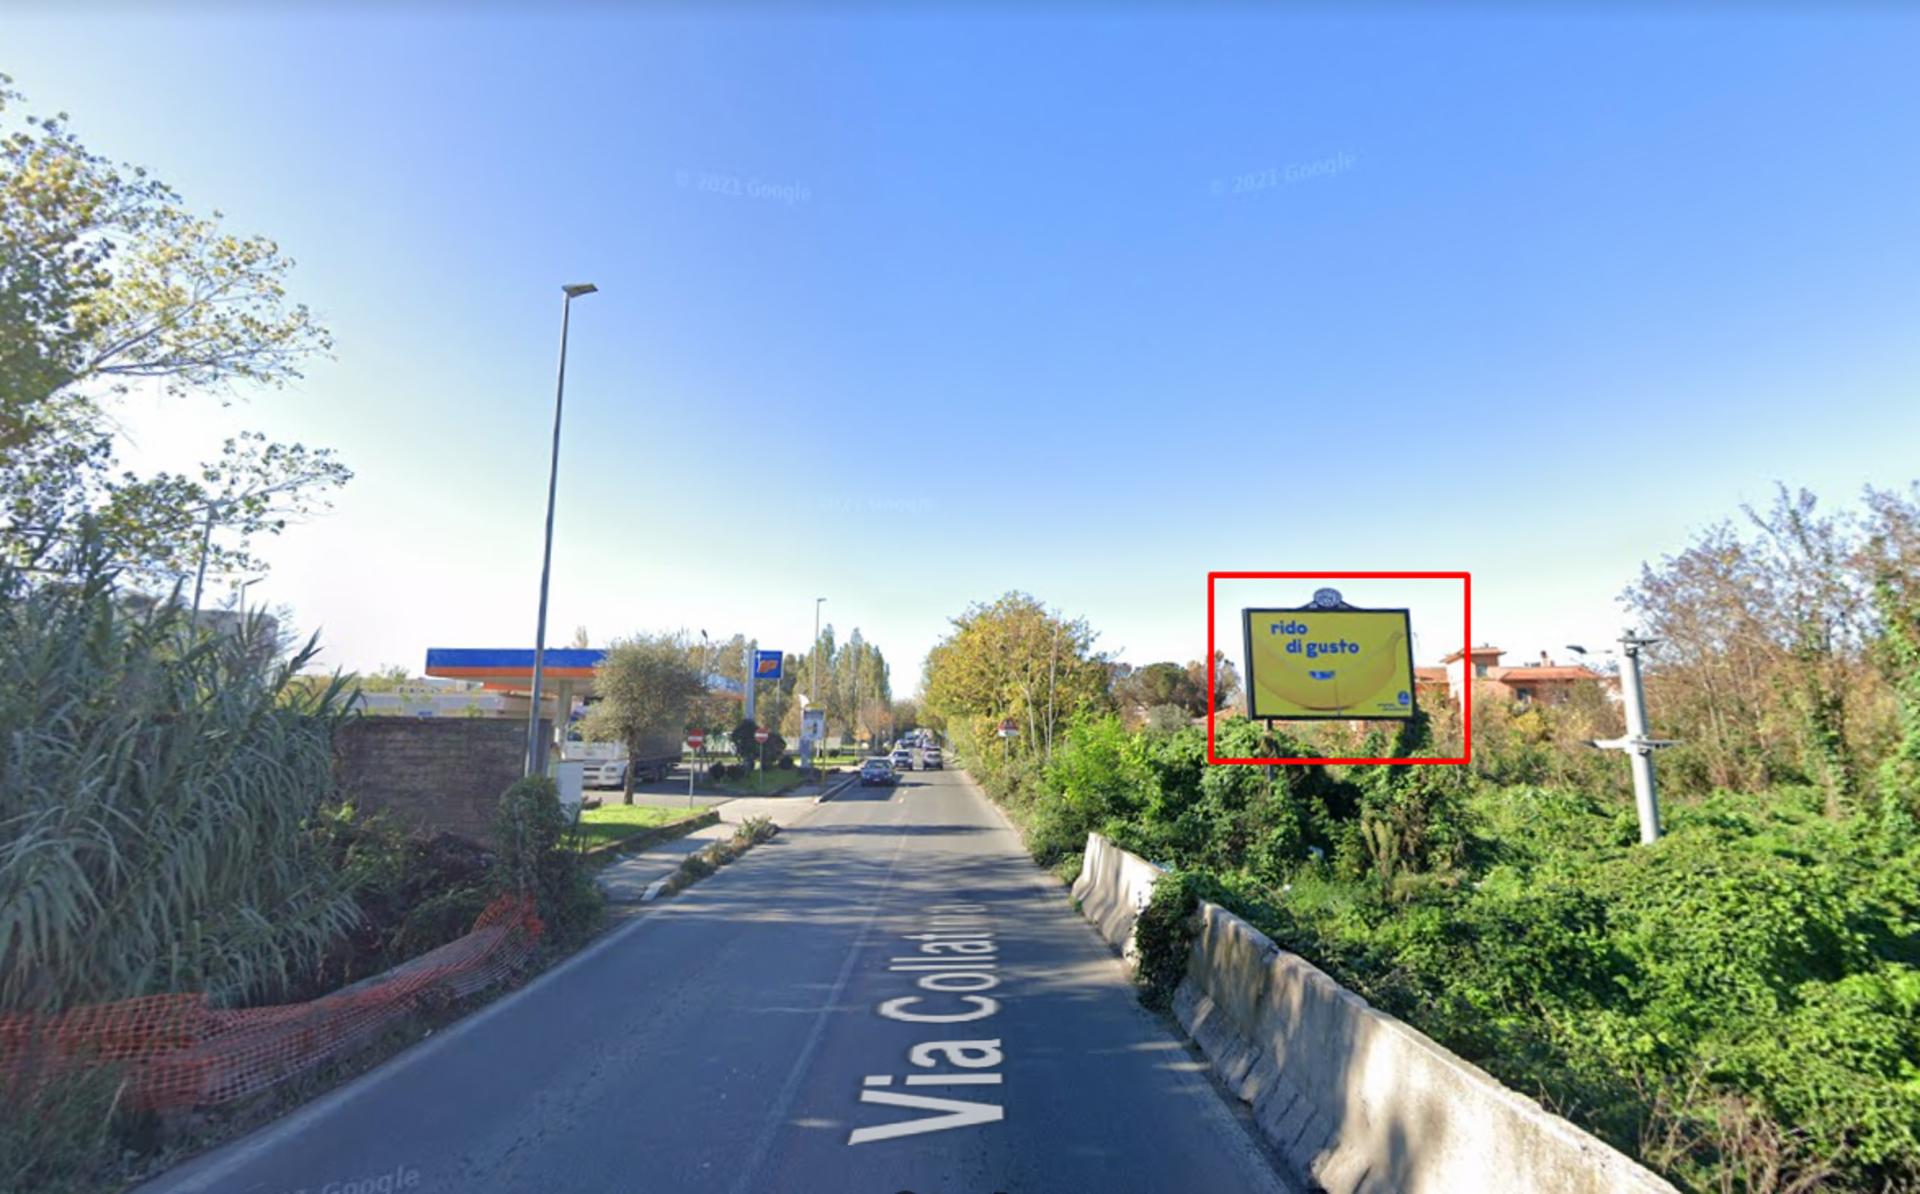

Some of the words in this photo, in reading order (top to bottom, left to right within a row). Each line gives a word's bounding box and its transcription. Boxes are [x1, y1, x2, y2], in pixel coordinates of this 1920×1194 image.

[1271, 619, 1308, 635] rido
[1286, 638, 1302, 654] di
[1306, 638, 1360, 658] gusto
